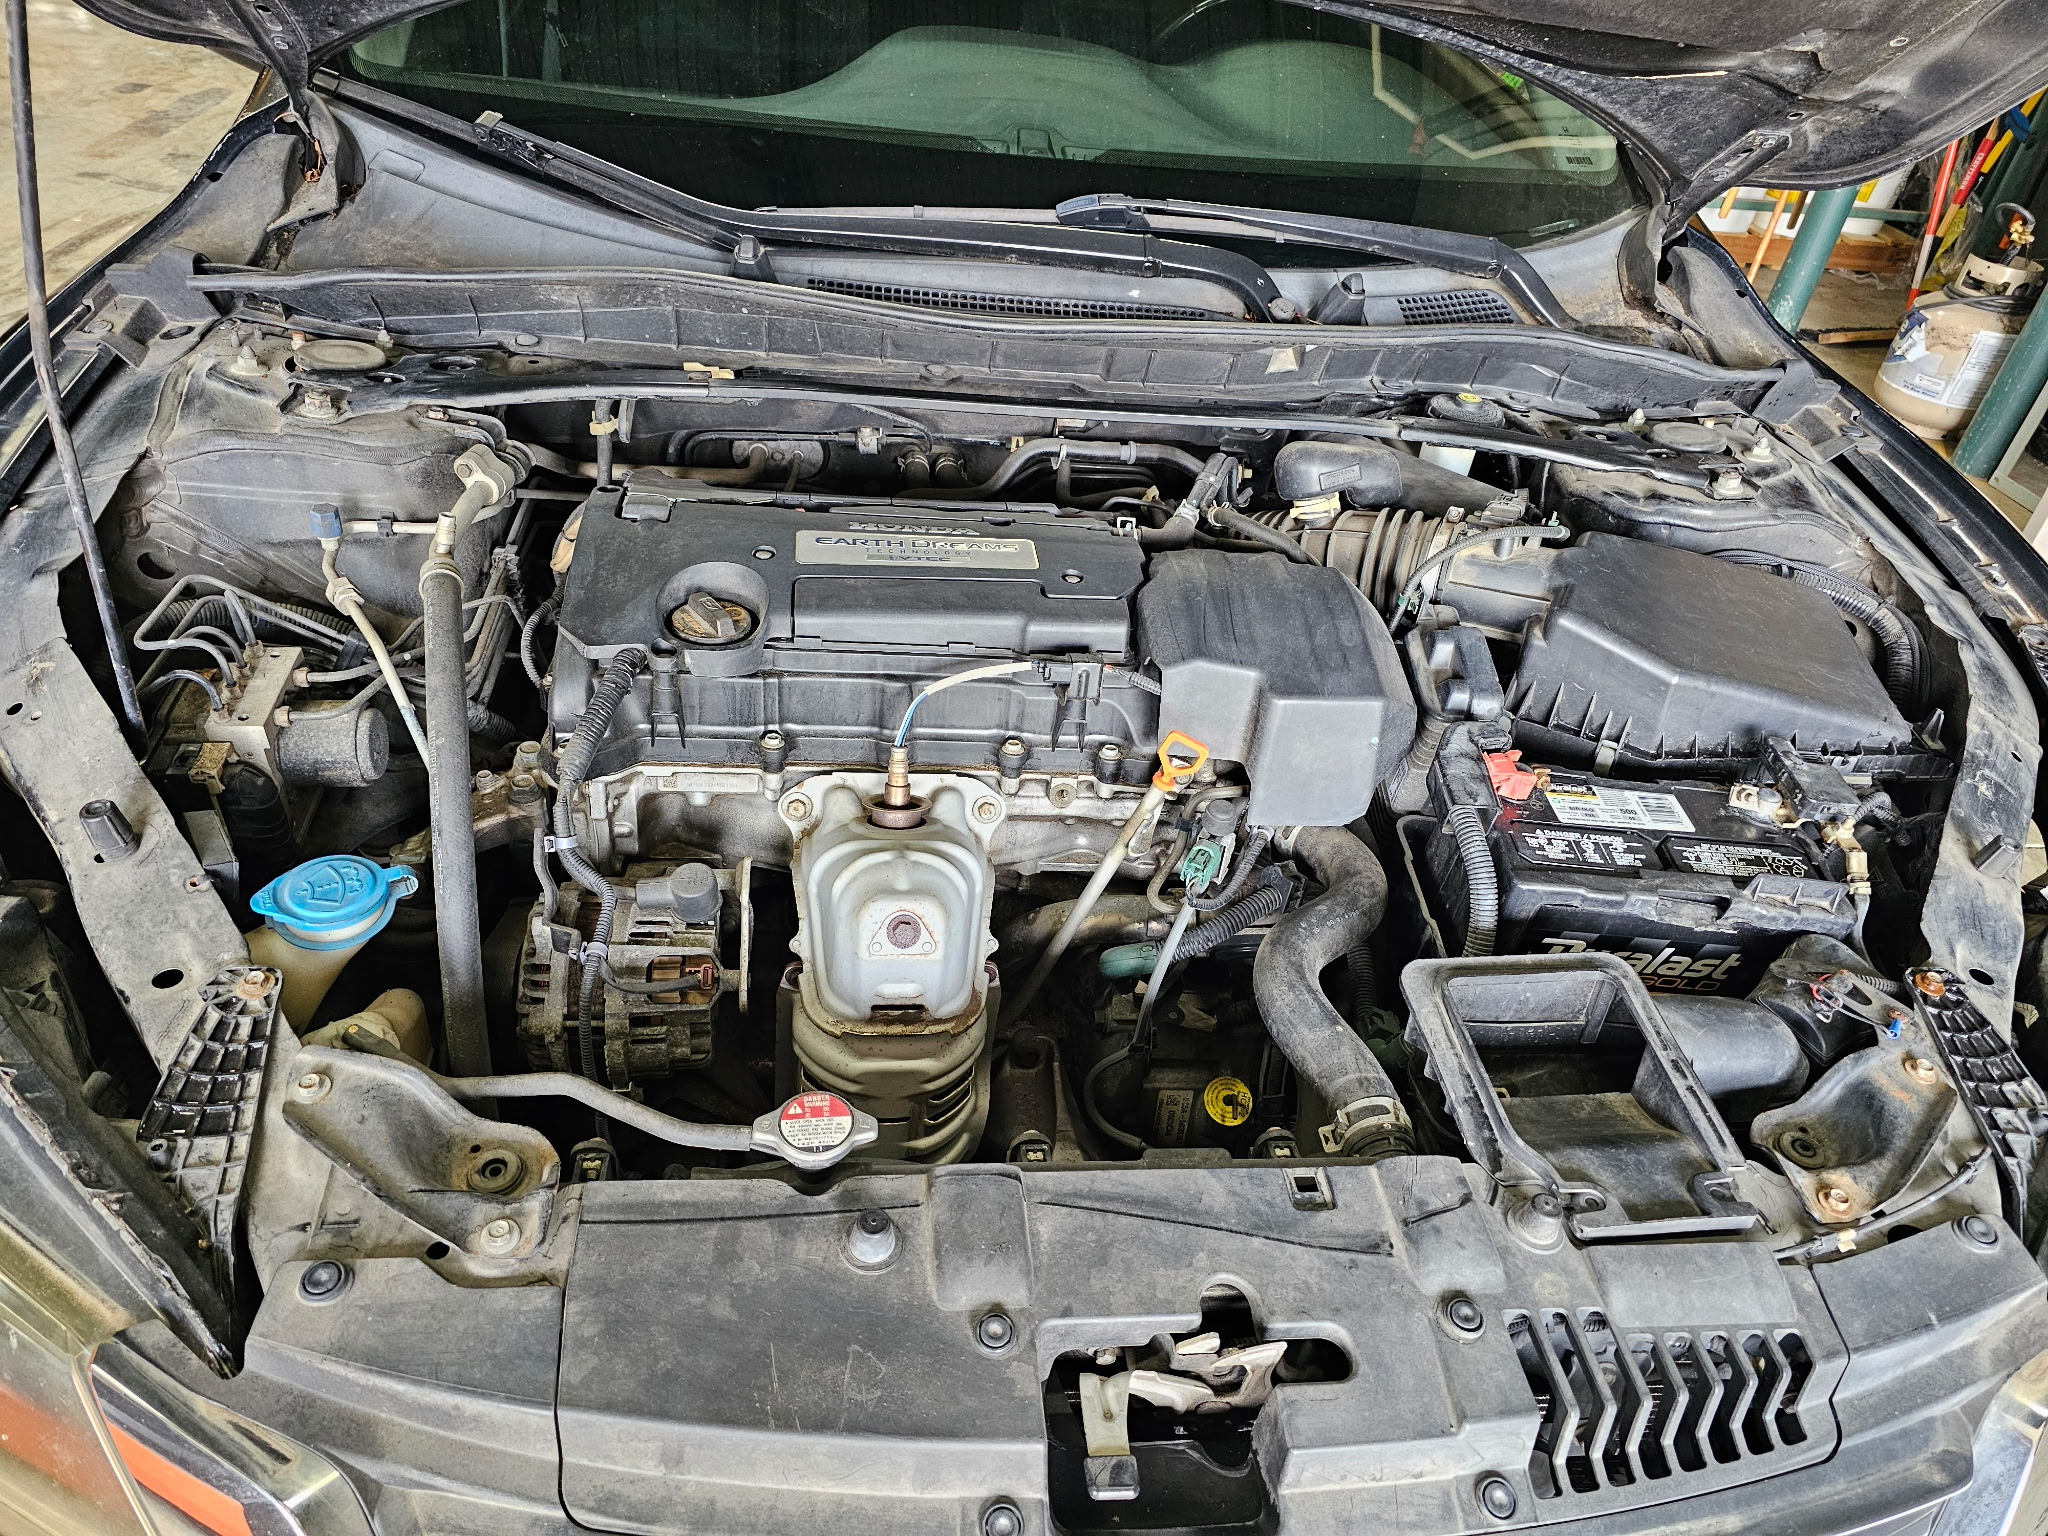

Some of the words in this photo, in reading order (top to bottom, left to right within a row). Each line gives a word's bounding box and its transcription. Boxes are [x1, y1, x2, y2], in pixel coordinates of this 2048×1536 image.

[849, 521, 980, 535] HONDA
[814, 536, 905, 549] EARTH
[911, 539, 1019, 552] DREAMS
[865, 548, 971, 556] TECHNOLOGY
[1543, 829, 1581, 839] DANGER
[1589, 834, 1624, 842] POISON
[260, 890, 273, 908] PULL
